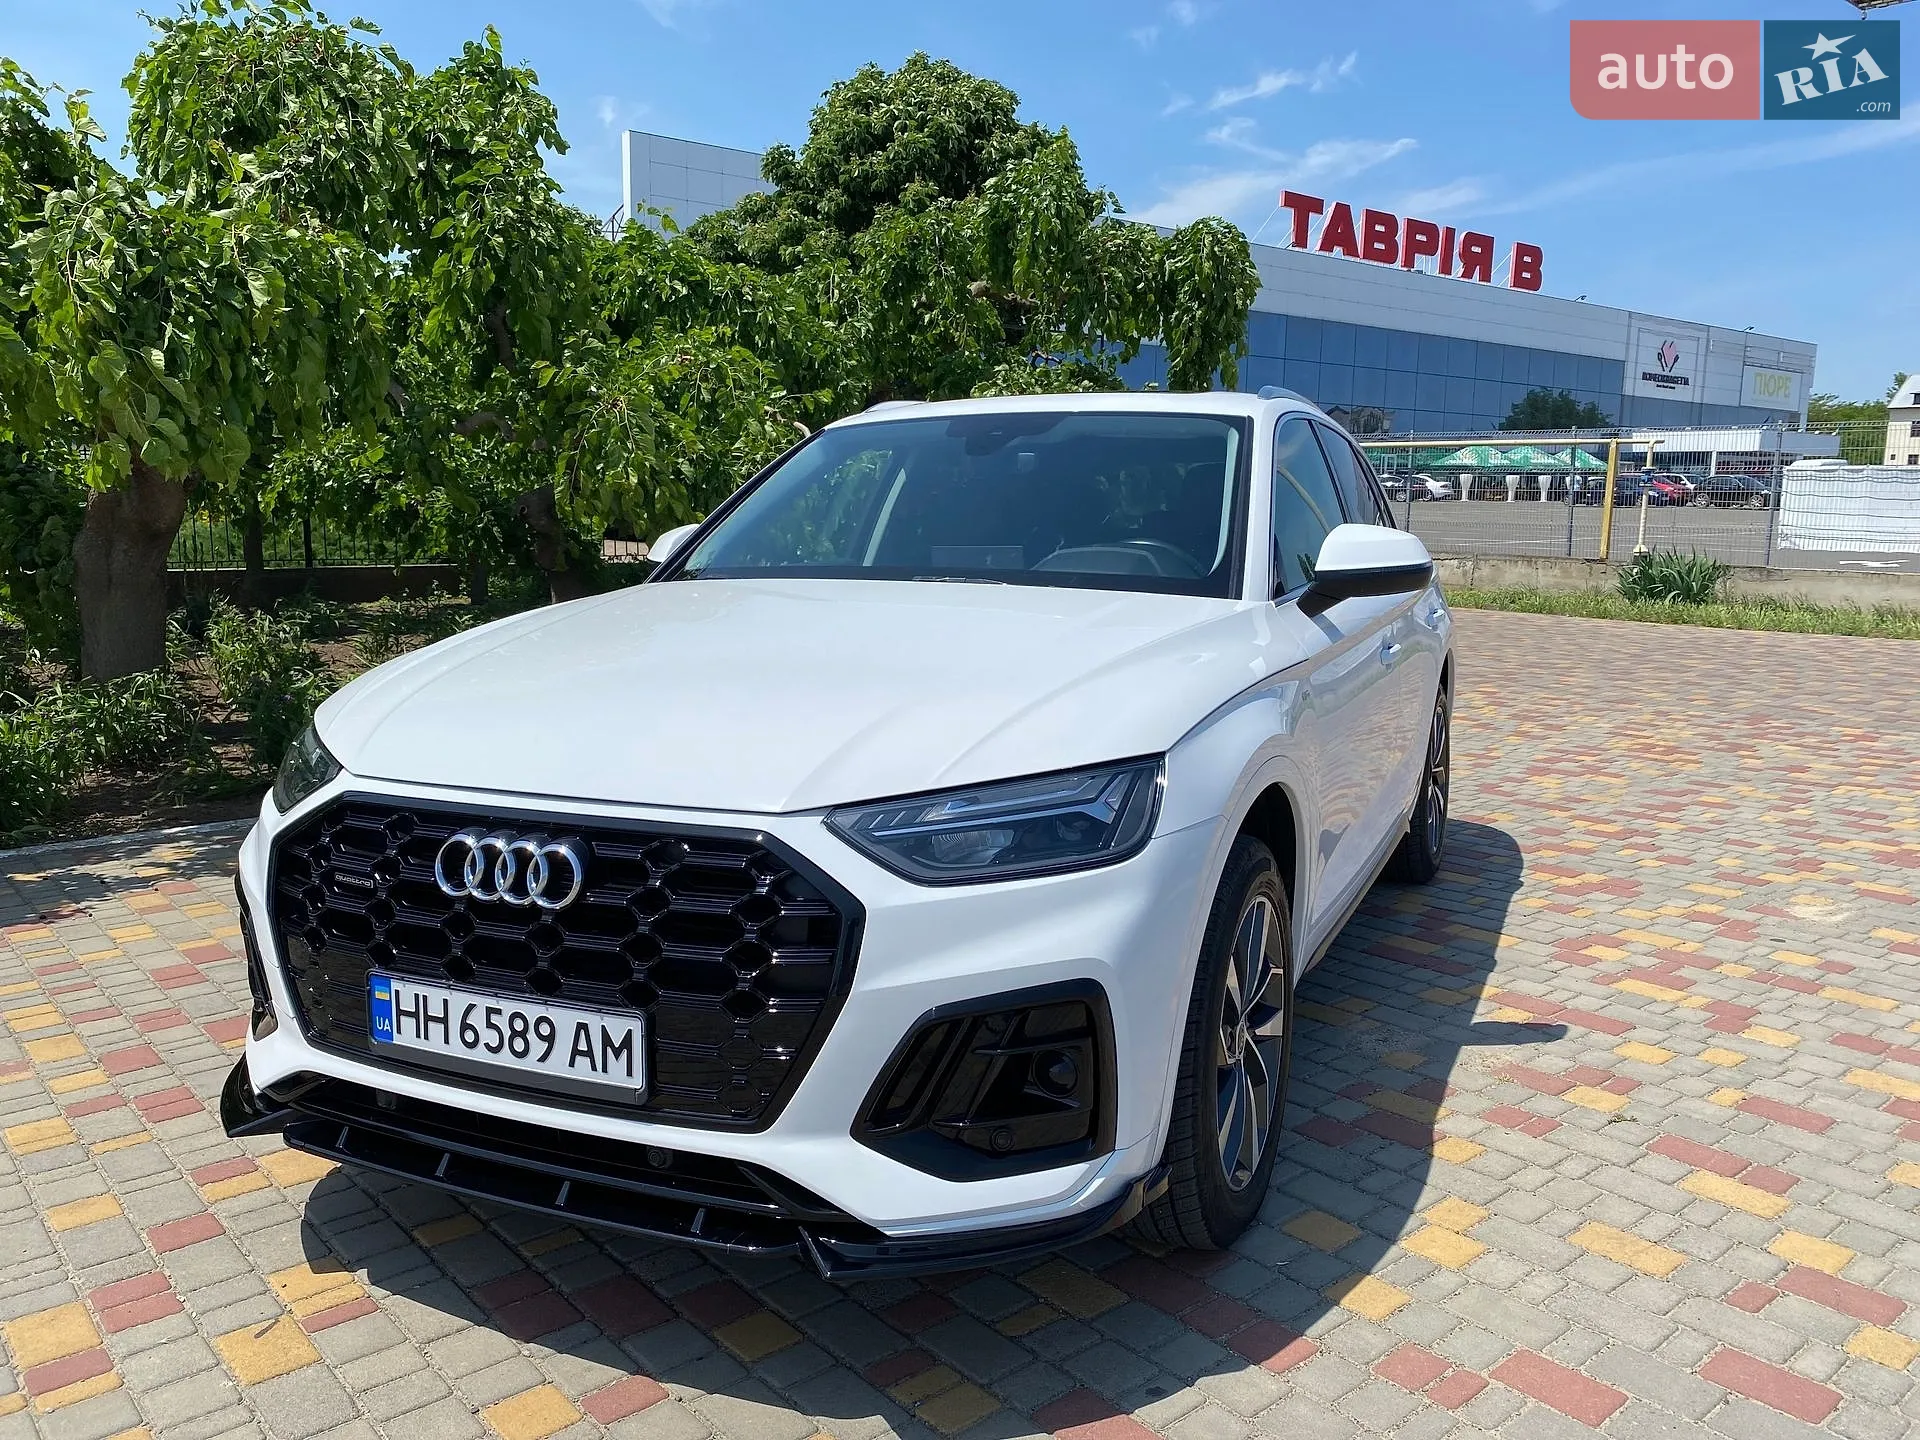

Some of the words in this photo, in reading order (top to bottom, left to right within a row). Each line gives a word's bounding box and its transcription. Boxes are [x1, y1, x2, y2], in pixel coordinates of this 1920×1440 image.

[1280, 189, 1496, 284] ТАВРІЯ
[1508, 241, 1544, 292] В
[1752, 371, 1792, 399] ПЮРЕ
[335, 874, 371, 887] quattro
[376, 1015, 392, 1033] UA
[394, 988, 450, 1046] HH
[459, 1002, 557, 1064] 6589
[568, 1020, 634, 1078] AM
